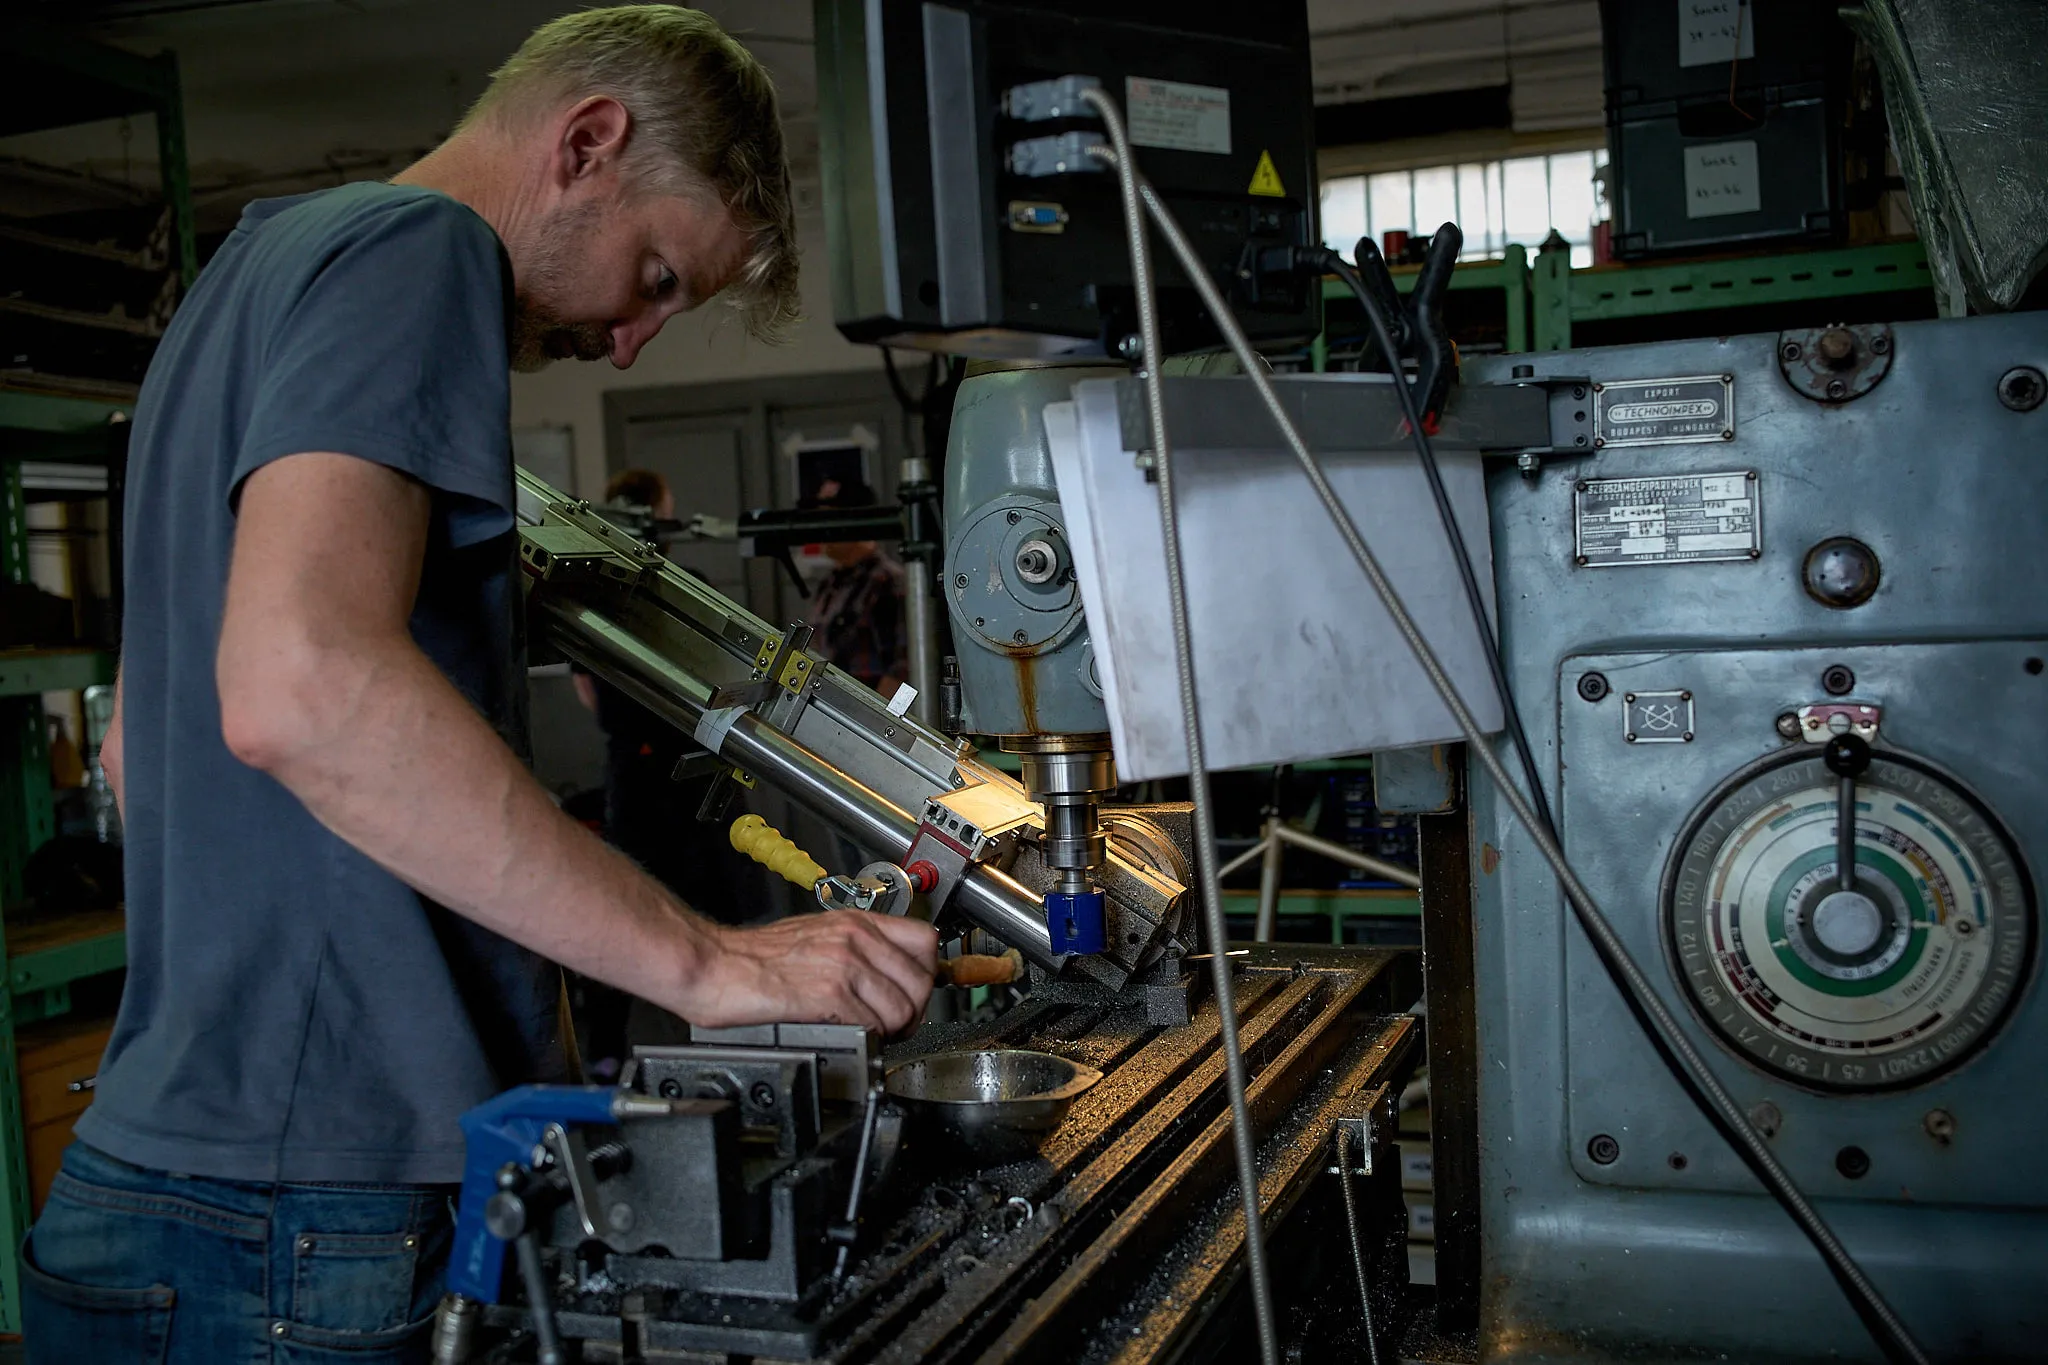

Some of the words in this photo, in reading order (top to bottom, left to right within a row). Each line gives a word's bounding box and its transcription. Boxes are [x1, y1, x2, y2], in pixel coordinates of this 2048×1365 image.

[1644, 388, 1680, 398] EXPORT
[1624, 404, 1703, 418] TECHNOIMPEX
[1610, 426, 1658, 437] BUDAPEST
[1672, 422, 1716, 433] HUNGARY
